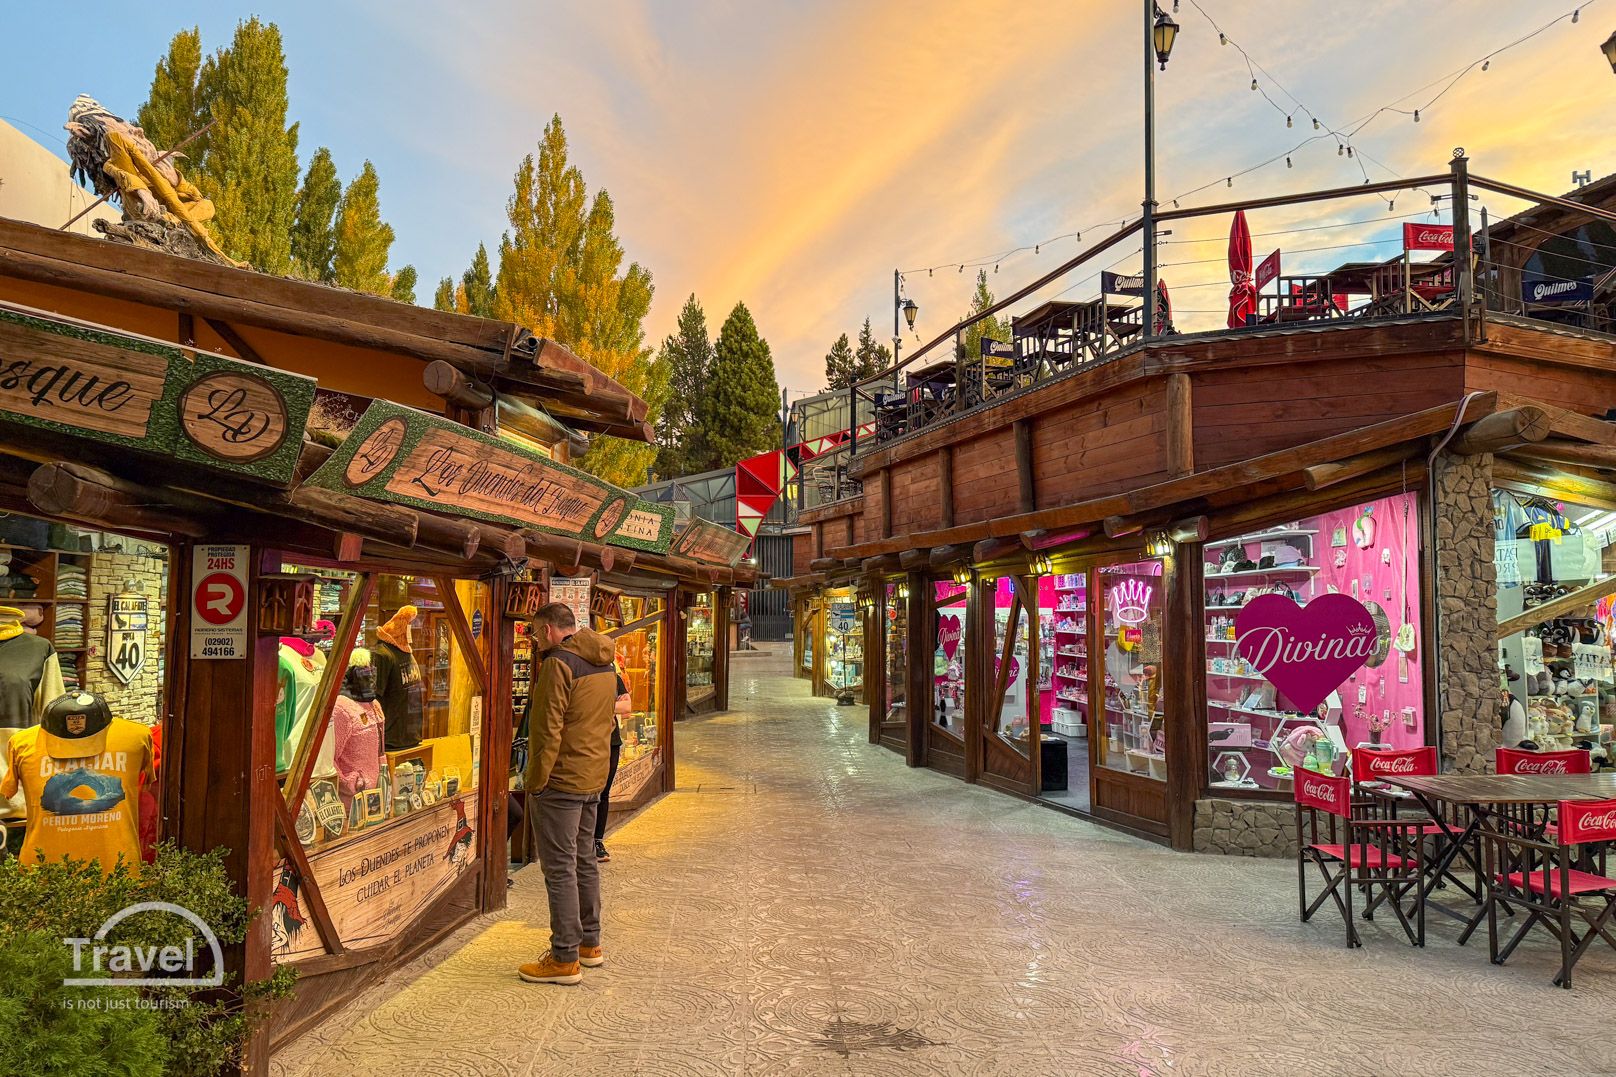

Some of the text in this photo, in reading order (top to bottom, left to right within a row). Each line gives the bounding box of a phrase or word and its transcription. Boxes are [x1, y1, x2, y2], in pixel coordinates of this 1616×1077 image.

[1115, 275, 1144, 292] Quilme
[1533, 280, 1577, 300] Quilmes
[0, 361, 136, 412] sque
[411, 446, 465, 497] Los
[458, 459, 532, 501] Duendes
[621, 524, 653, 537] TINA
[207, 558, 235, 570] 24HS
[838, 621, 849, 631] 40
[204, 637, 234, 646] (02902)
[1231, 626, 1391, 675] Divinas
[115, 642, 140, 670] 40
[202, 647, 235, 656] 494166
[1370, 756, 1416, 773] Coca-Cola
[1514, 758, 1567, 774] Coca-Cola
[1303, 779, 1336, 802] Coca-Cola
[43, 812, 122, 827] PERITO MORENO
[1578, 810, 1616, 831] Coca-Co
[402, 841, 412, 855] TE
[414, 823, 450, 852] PROPONEN
[356, 853, 435, 903] CUIDAR EL PLANETA
